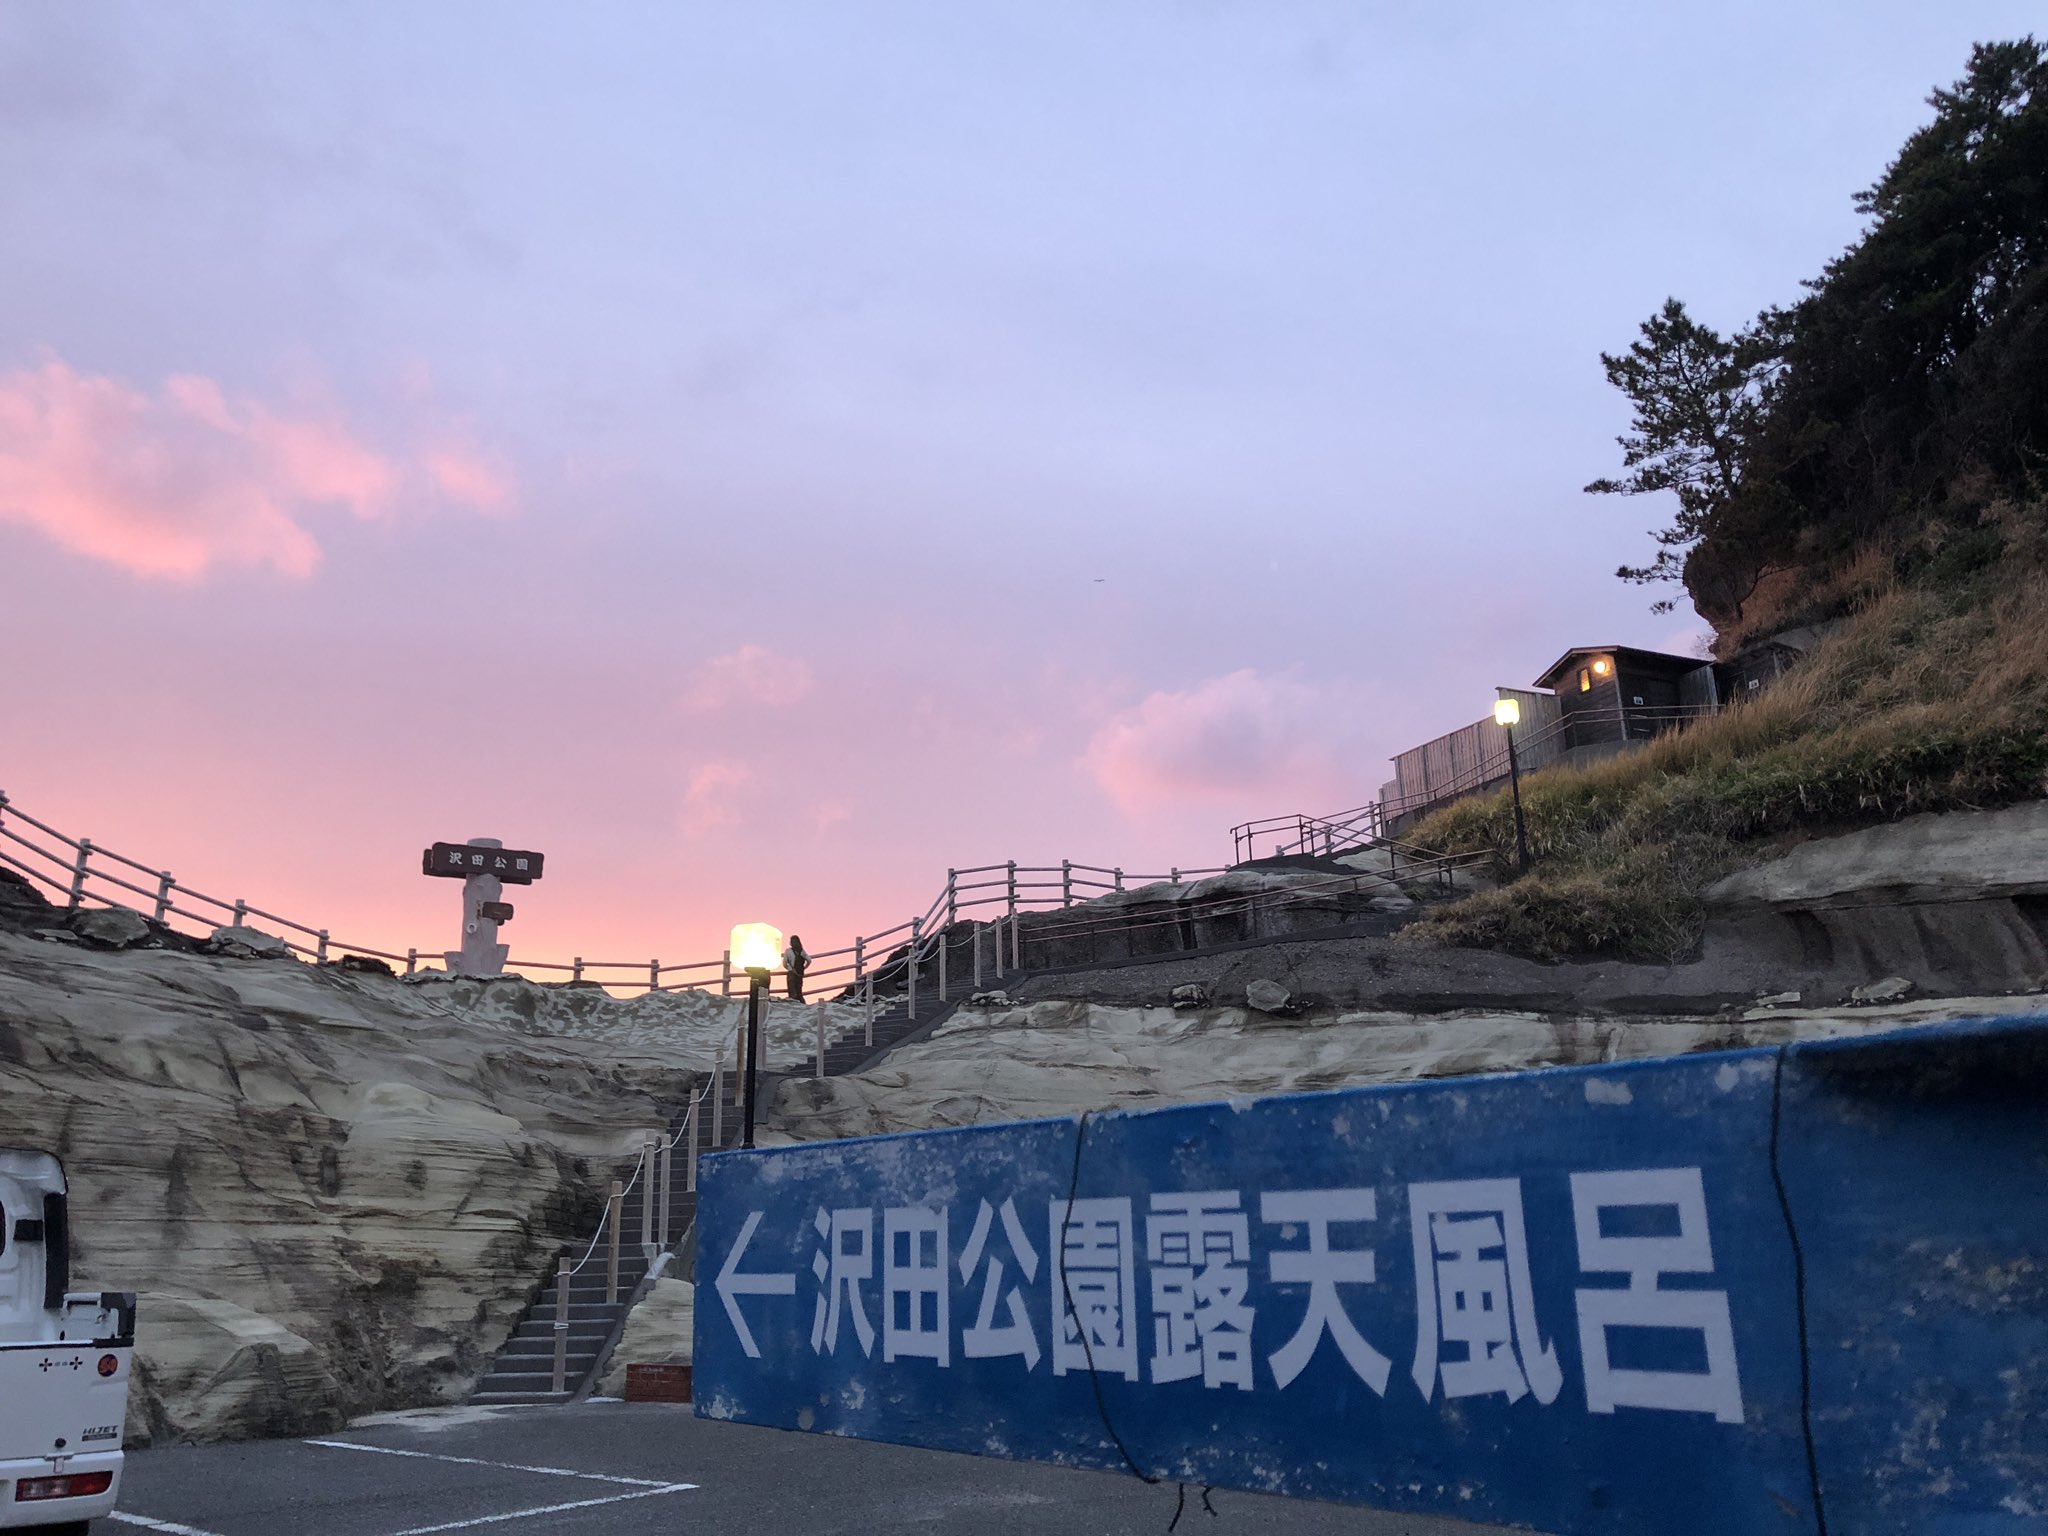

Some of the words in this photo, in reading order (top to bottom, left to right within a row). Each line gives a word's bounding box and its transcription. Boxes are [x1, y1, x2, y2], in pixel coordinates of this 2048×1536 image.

[810, 1167, 1745, 1424] 沢田公園露天風呂
[83, 1425, 118, 1434] HIJET
